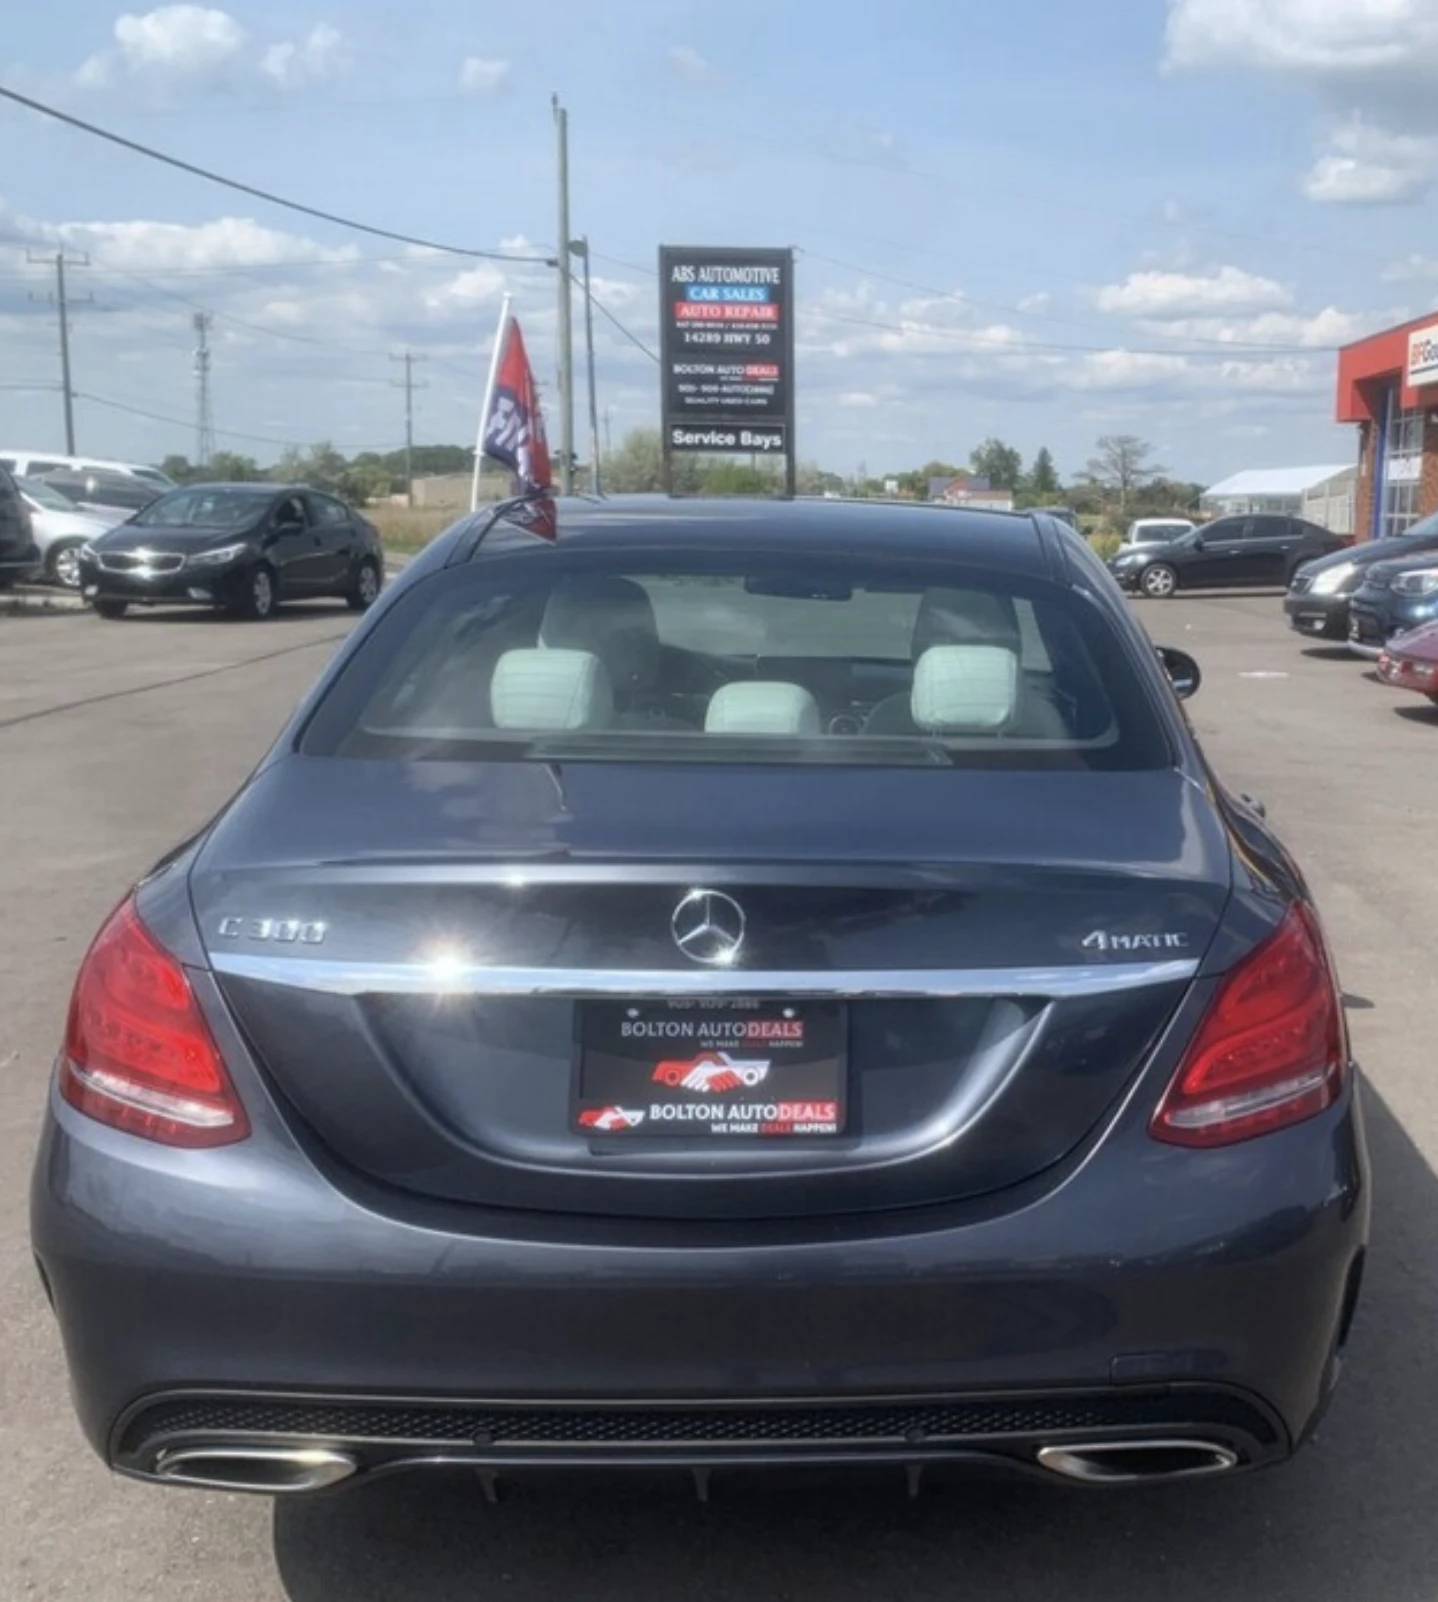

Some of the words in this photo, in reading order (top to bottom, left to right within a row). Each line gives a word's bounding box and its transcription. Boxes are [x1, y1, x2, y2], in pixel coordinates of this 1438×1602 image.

[672, 265, 695, 282] ABS
[698, 266, 781, 284] AUTOMOTIVE
[689, 286, 719, 301] CAR
[722, 286, 765, 302] SALES
[680, 304, 722, 318] AUTO
[724, 304, 776, 320] REPAIR
[683, 332, 721, 344] 14289
[723, 333, 752, 345] HWY
[755, 333, 771, 345] 50
[673, 364, 714, 374] BOLTON
[672, 429, 736, 446] Service
[740, 431, 781, 449] Bays
[219, 918, 242, 936] C
[247, 918, 327, 942] 300
[1082, 930, 1189, 950] 4MATIC
[621, 1022, 693, 1037] BOLTON
[699, 1021, 803, 1038] AUTODEALS
[650, 1104, 724, 1119] BOLTON
[727, 1103, 836, 1120] AUTODEALS
[711, 1123, 728, 1133] WE
[730, 1123, 758, 1133] MAKE
[762, 1123, 790, 1133] DEALS
